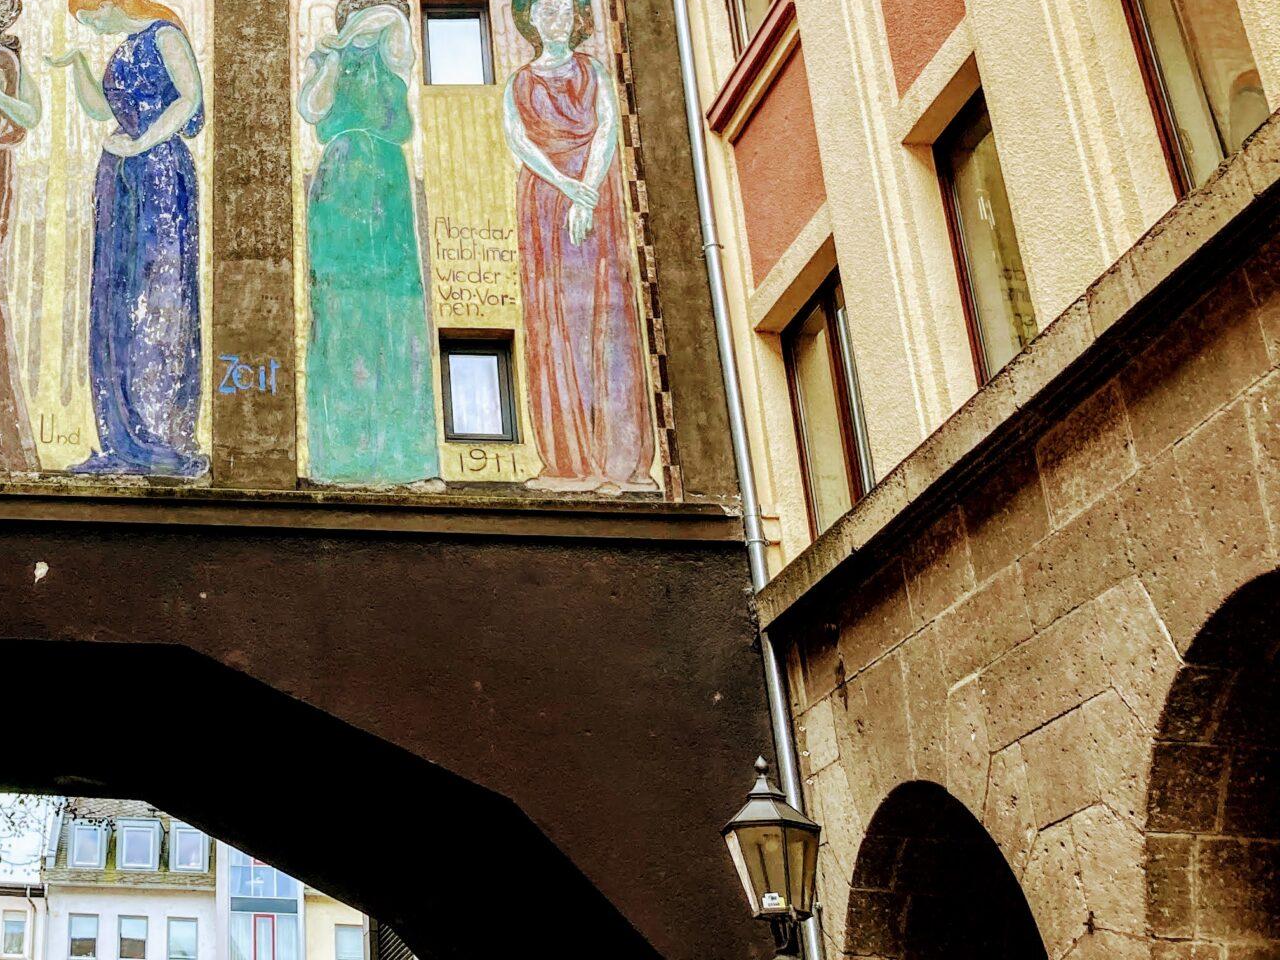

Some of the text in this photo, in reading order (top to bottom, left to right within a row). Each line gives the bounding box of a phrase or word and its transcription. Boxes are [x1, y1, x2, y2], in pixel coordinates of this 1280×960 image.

[434, 216, 513, 240] Aber das
[435, 239, 478, 261] treibt
[217, 353, 280, 396] Zeit
[40, 413, 81, 445] Und
